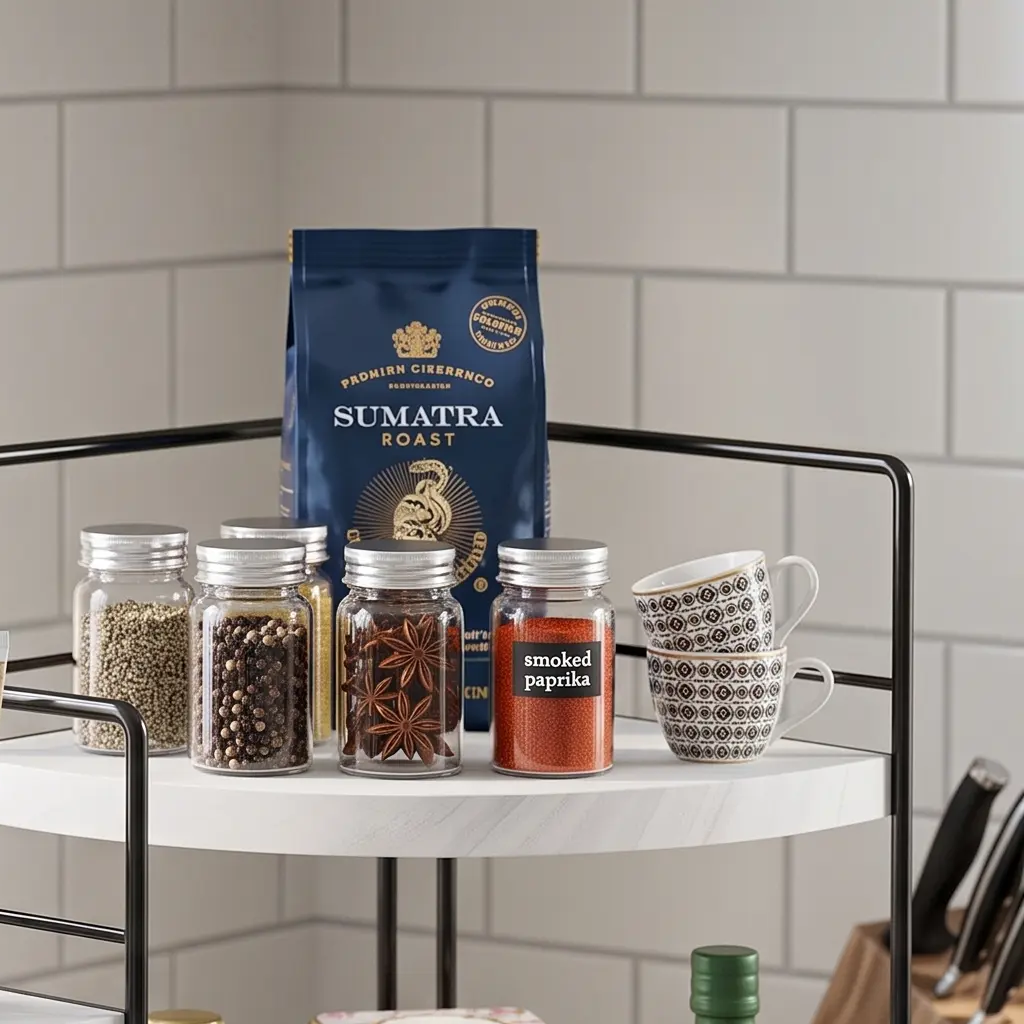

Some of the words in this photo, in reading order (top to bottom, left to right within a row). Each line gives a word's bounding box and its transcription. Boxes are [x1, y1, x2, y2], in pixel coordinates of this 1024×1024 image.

[333, 405, 504, 428] SUMATRA
[381, 432, 456, 447] ROAST
[524, 649, 592, 668] smoked
[524, 670, 591, 692] paprika
